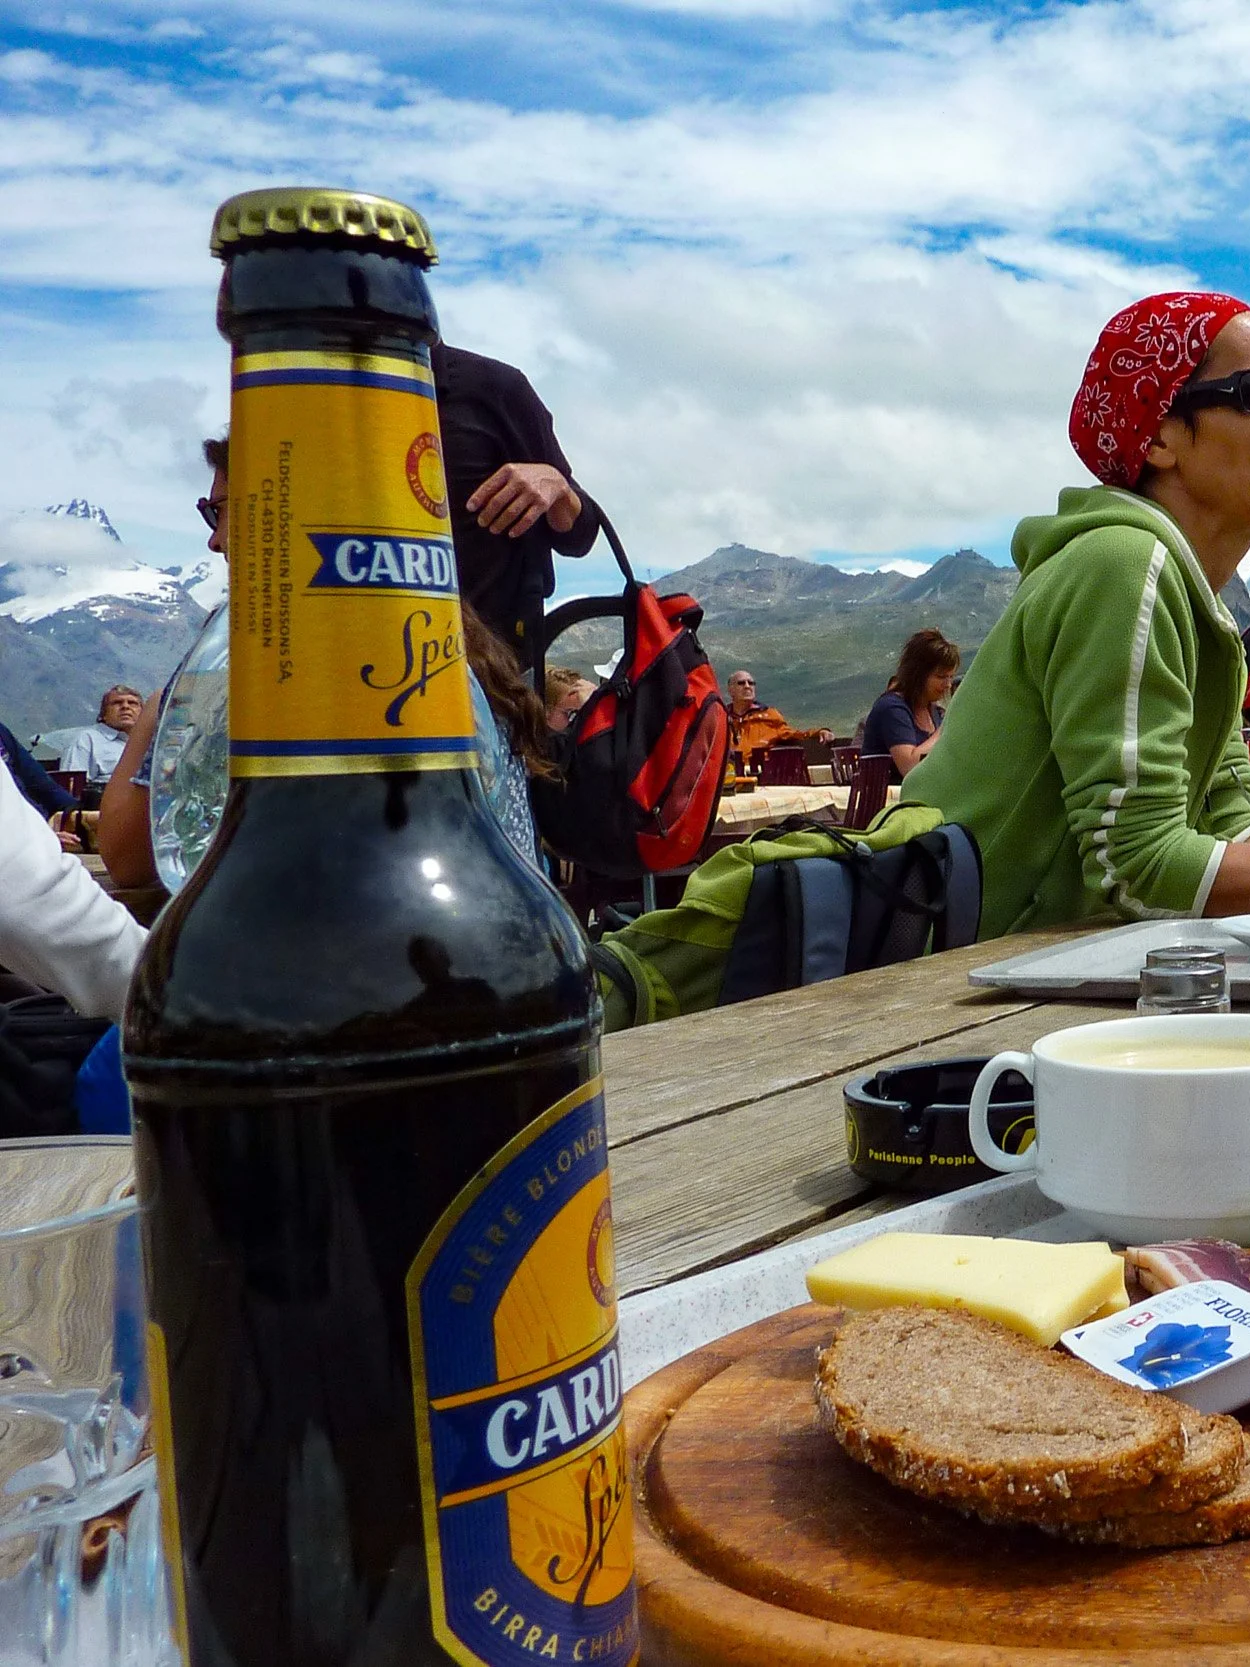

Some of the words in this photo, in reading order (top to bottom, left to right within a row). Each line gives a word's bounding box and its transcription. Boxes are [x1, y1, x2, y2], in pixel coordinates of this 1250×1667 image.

[261, 478, 275, 543] CH-4310
[868, 1148, 924, 1165] Parisienne
[929, 1154, 976, 1167] People
[473, 1587, 560, 1659] BIRRA
